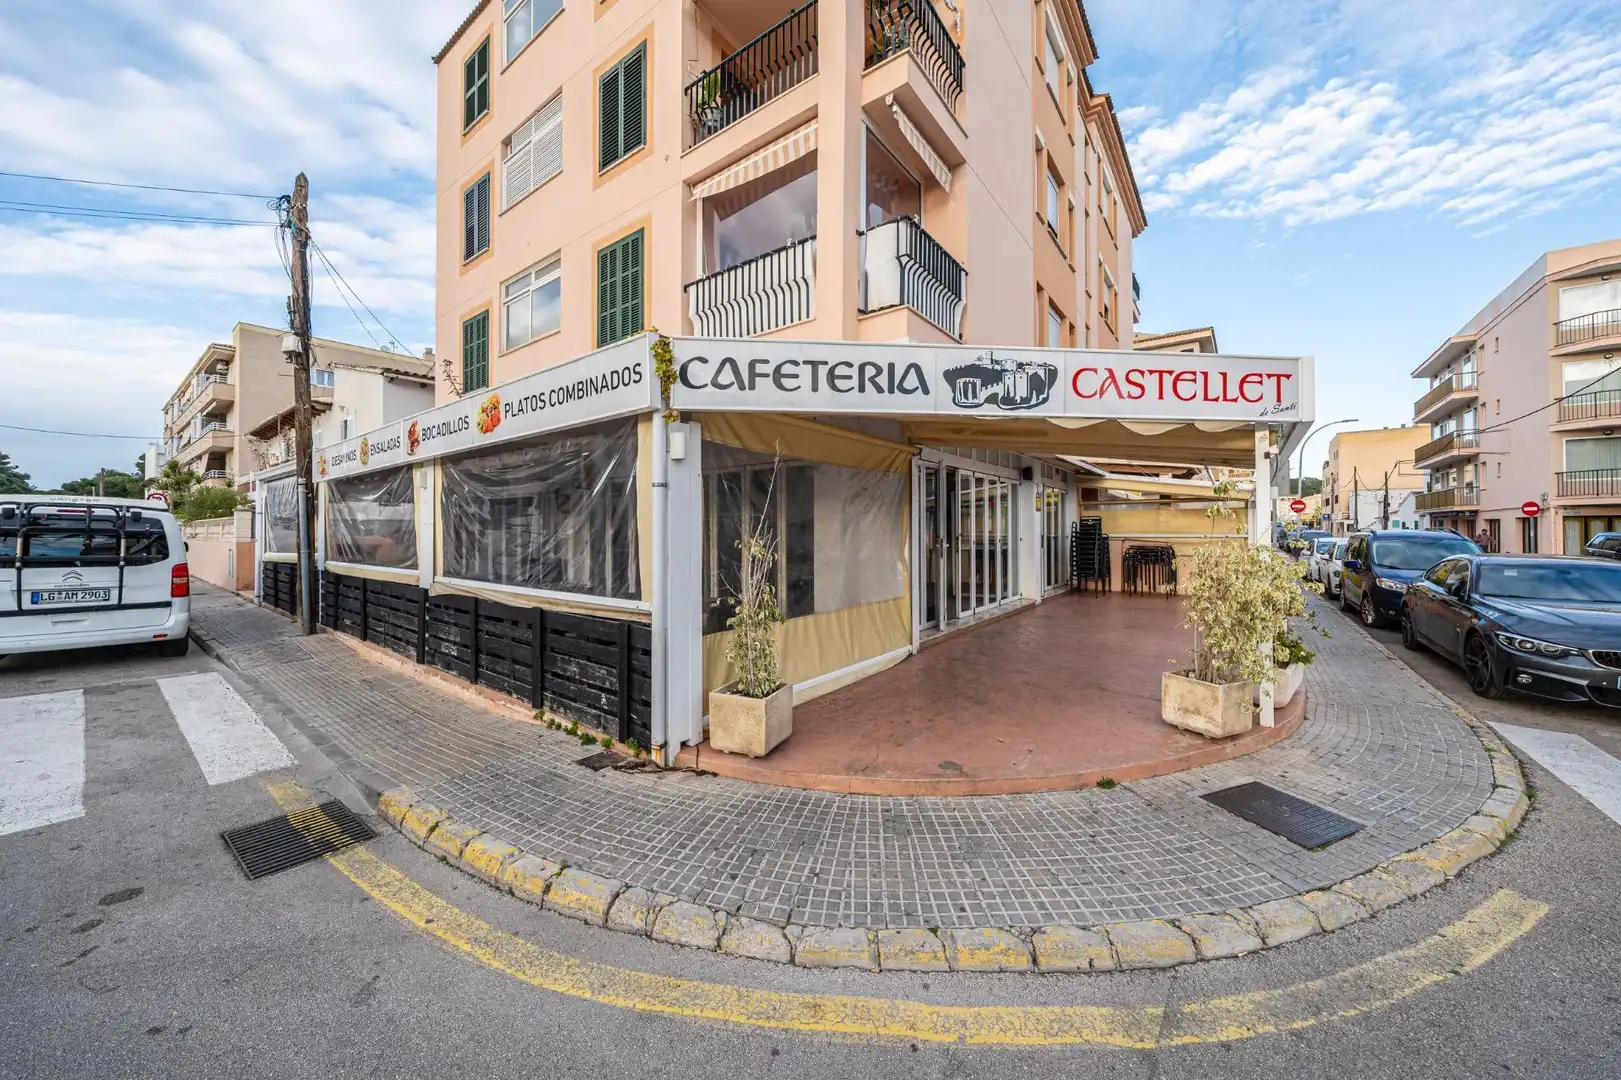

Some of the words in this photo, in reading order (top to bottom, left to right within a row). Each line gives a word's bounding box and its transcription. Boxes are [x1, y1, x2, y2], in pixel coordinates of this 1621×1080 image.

[678, 356, 931, 396] CAFETERIA
[1071, 367, 1293, 404] CASTELLET
[504, 391, 547, 420] PLATOS
[549, 362, 643, 407] COMBINADOS
[1257, 406, 1269, 418] de
[1270, 402, 1298, 415] Santi
[421, 415, 470, 442] BOCADILLOS
[370, 436, 401, 456] ENSALADAS
[40, 592, 56, 601] LG
[64, 591, 78, 600] AM
[80, 590, 108, 599] 2903
